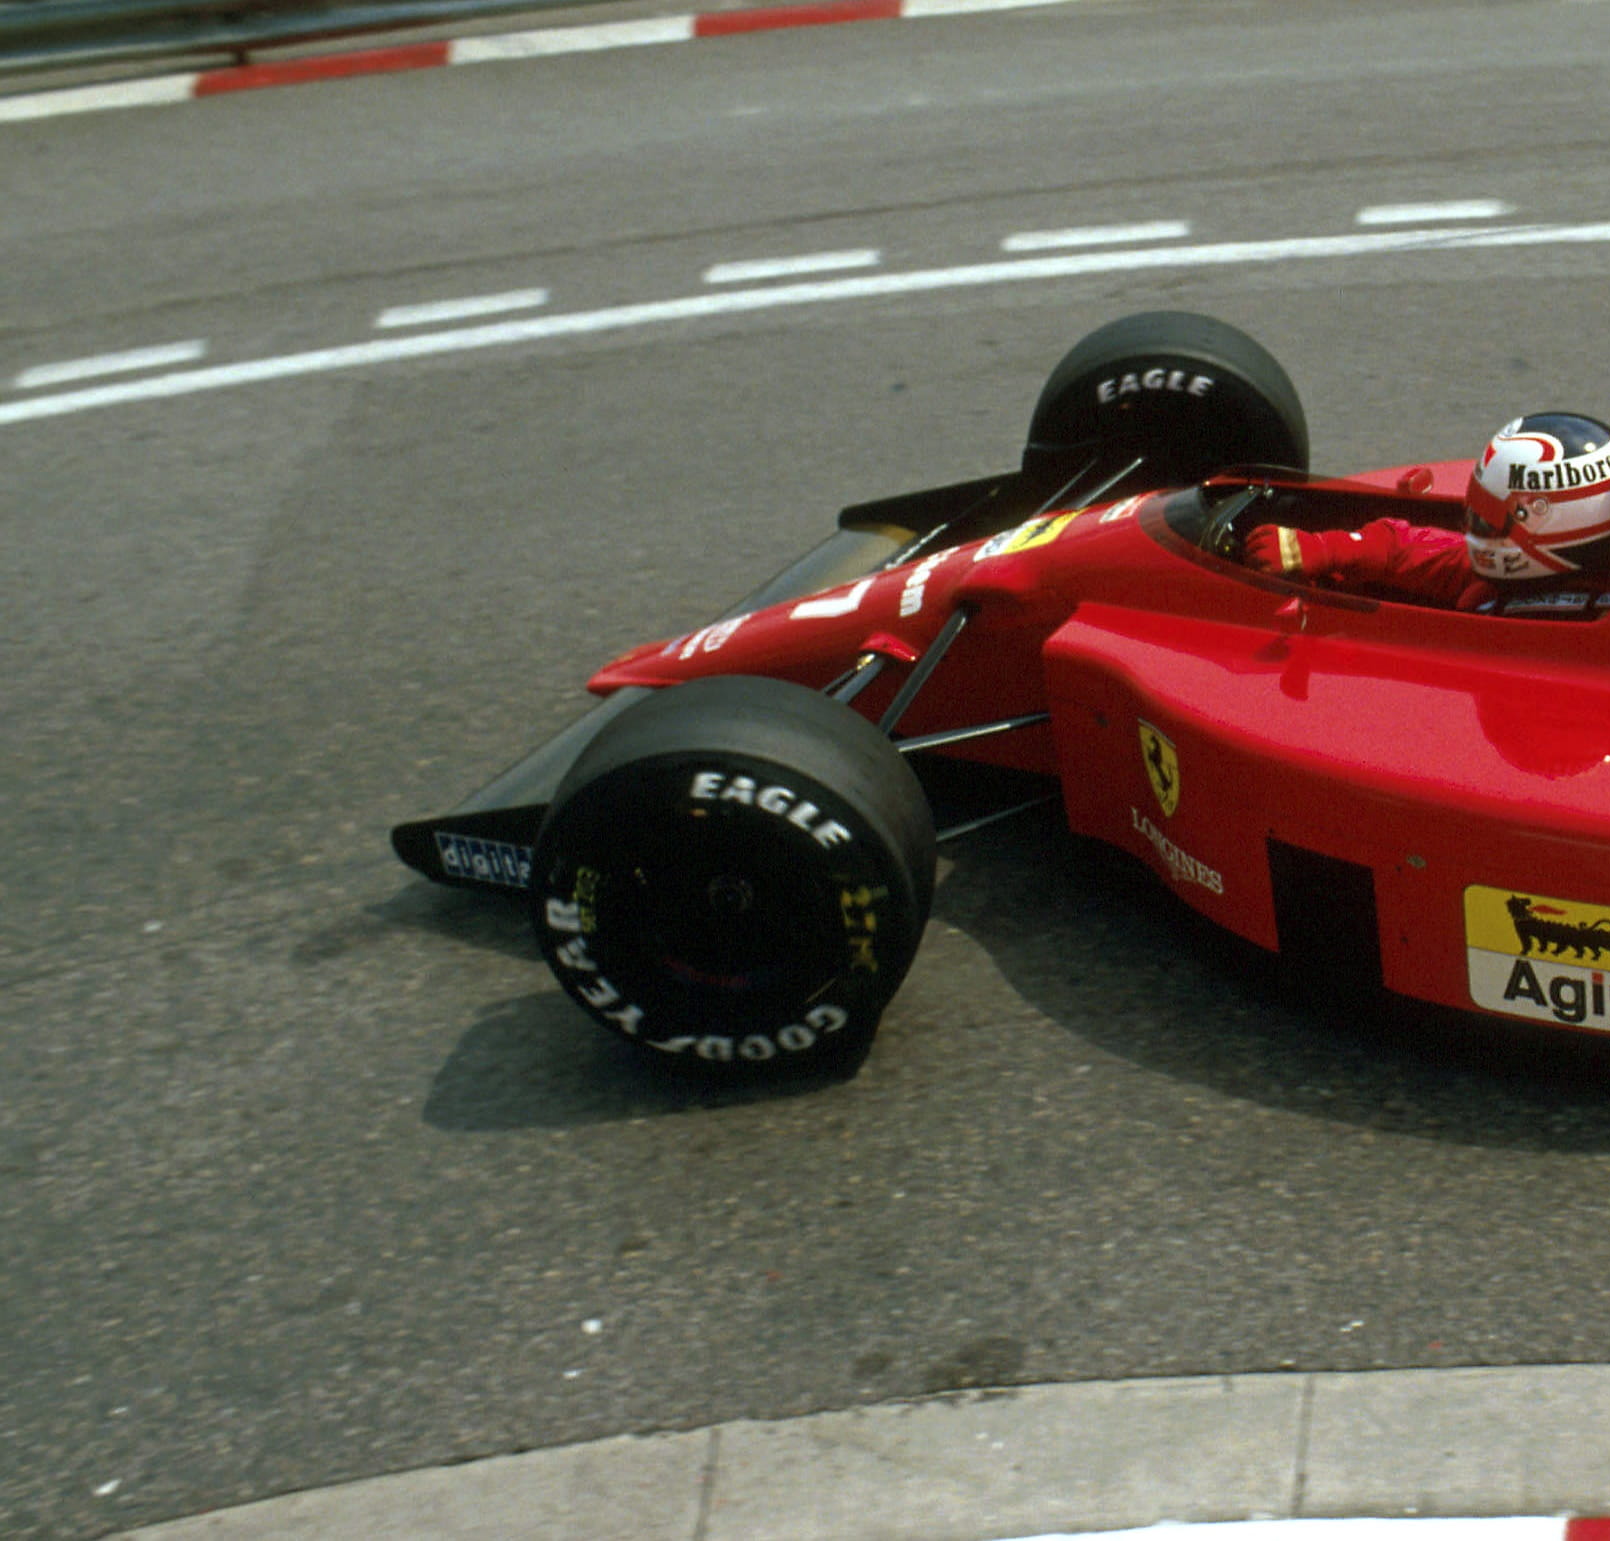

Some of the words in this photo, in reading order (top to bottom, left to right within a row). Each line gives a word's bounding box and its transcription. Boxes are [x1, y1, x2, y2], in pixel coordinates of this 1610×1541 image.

[1097, 367, 1214, 404] EAGLE
[691, 771, 852, 852] EAGLE
[1131, 806, 1223, 895] LONGINES
